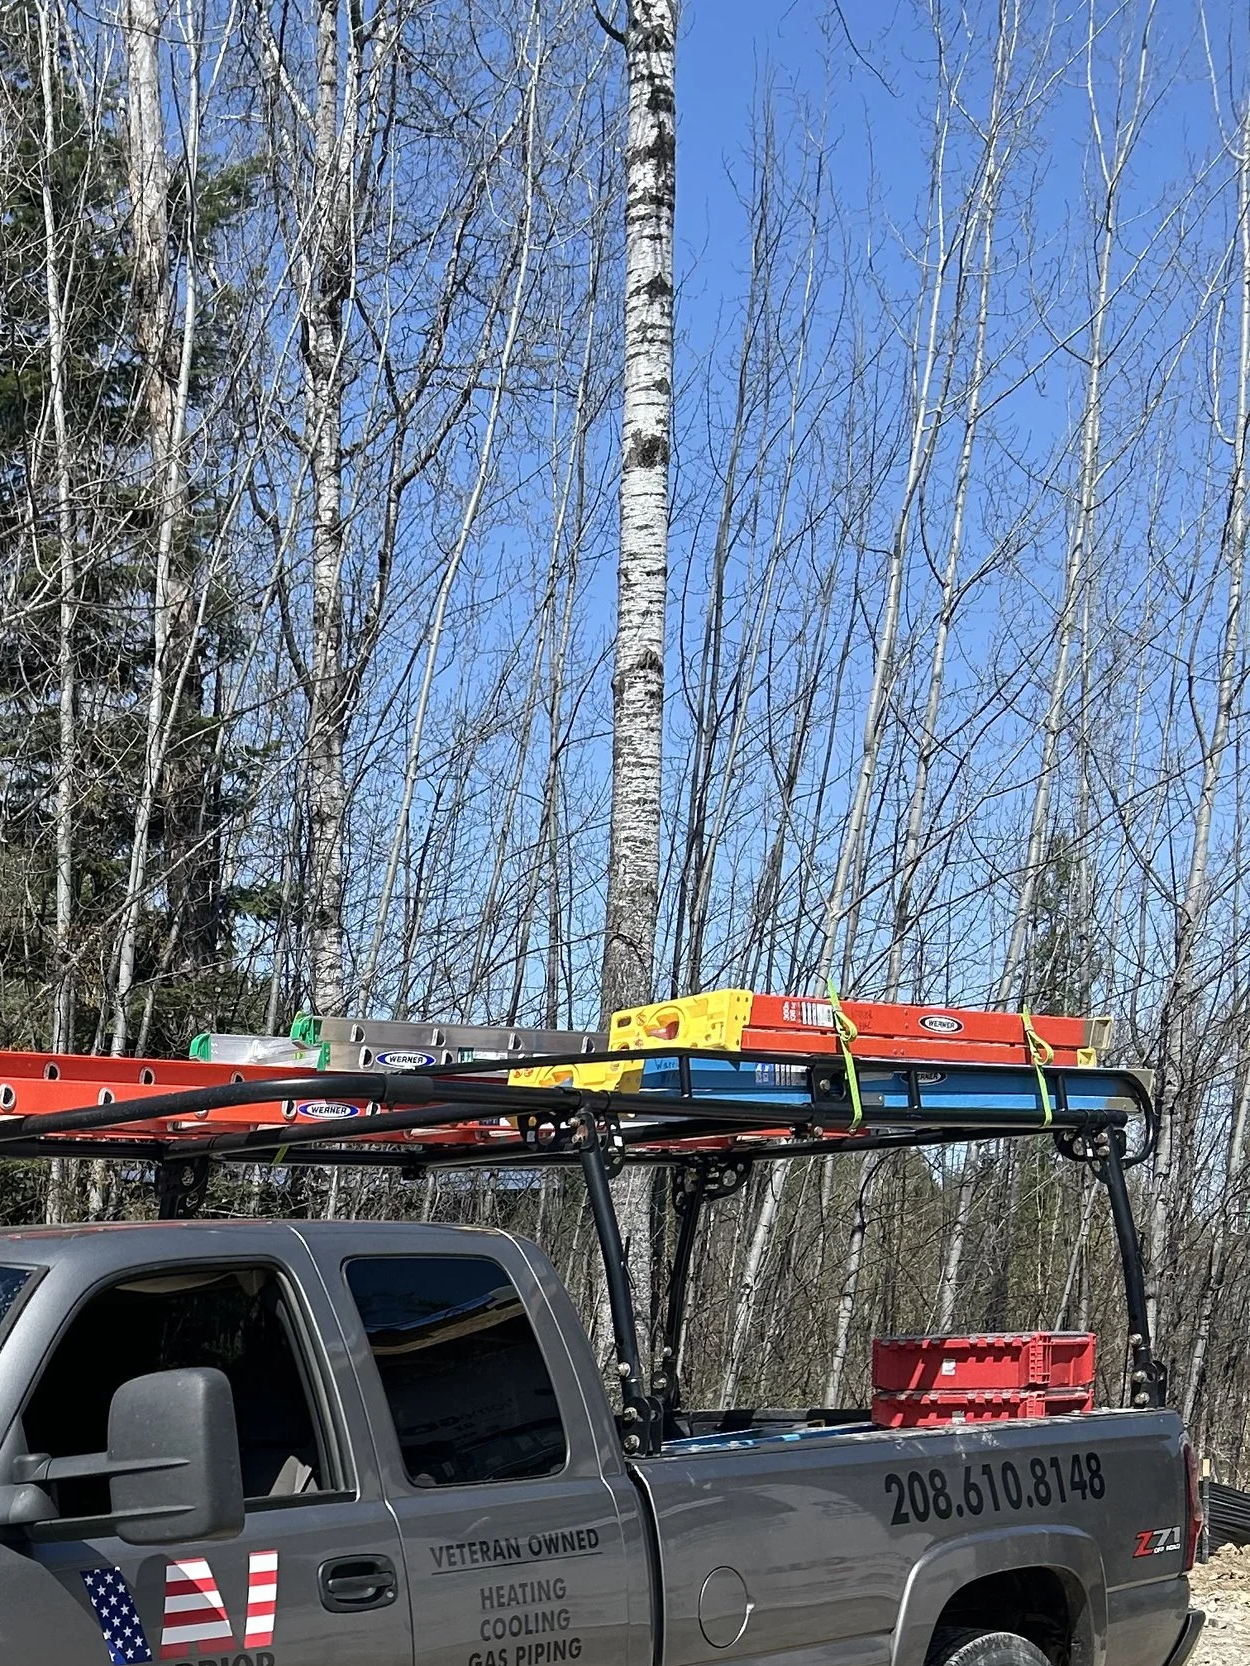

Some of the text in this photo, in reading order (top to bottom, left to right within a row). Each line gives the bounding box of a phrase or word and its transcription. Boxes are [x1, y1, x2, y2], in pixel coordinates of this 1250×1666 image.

[928, 1020, 955, 1029] WERNER
[389, 1056, 424, 1064] WERNER
[311, 1106, 347, 1114] WERNER
[884, 1452, 1106, 1526] 208.610.8148
[429, 1528, 600, 1568] VETERAN OWNED
[1133, 1526, 1181, 1558] Z71
[480, 1577, 566, 1610] HEATING
[480, 1608, 570, 1642] COOLING
